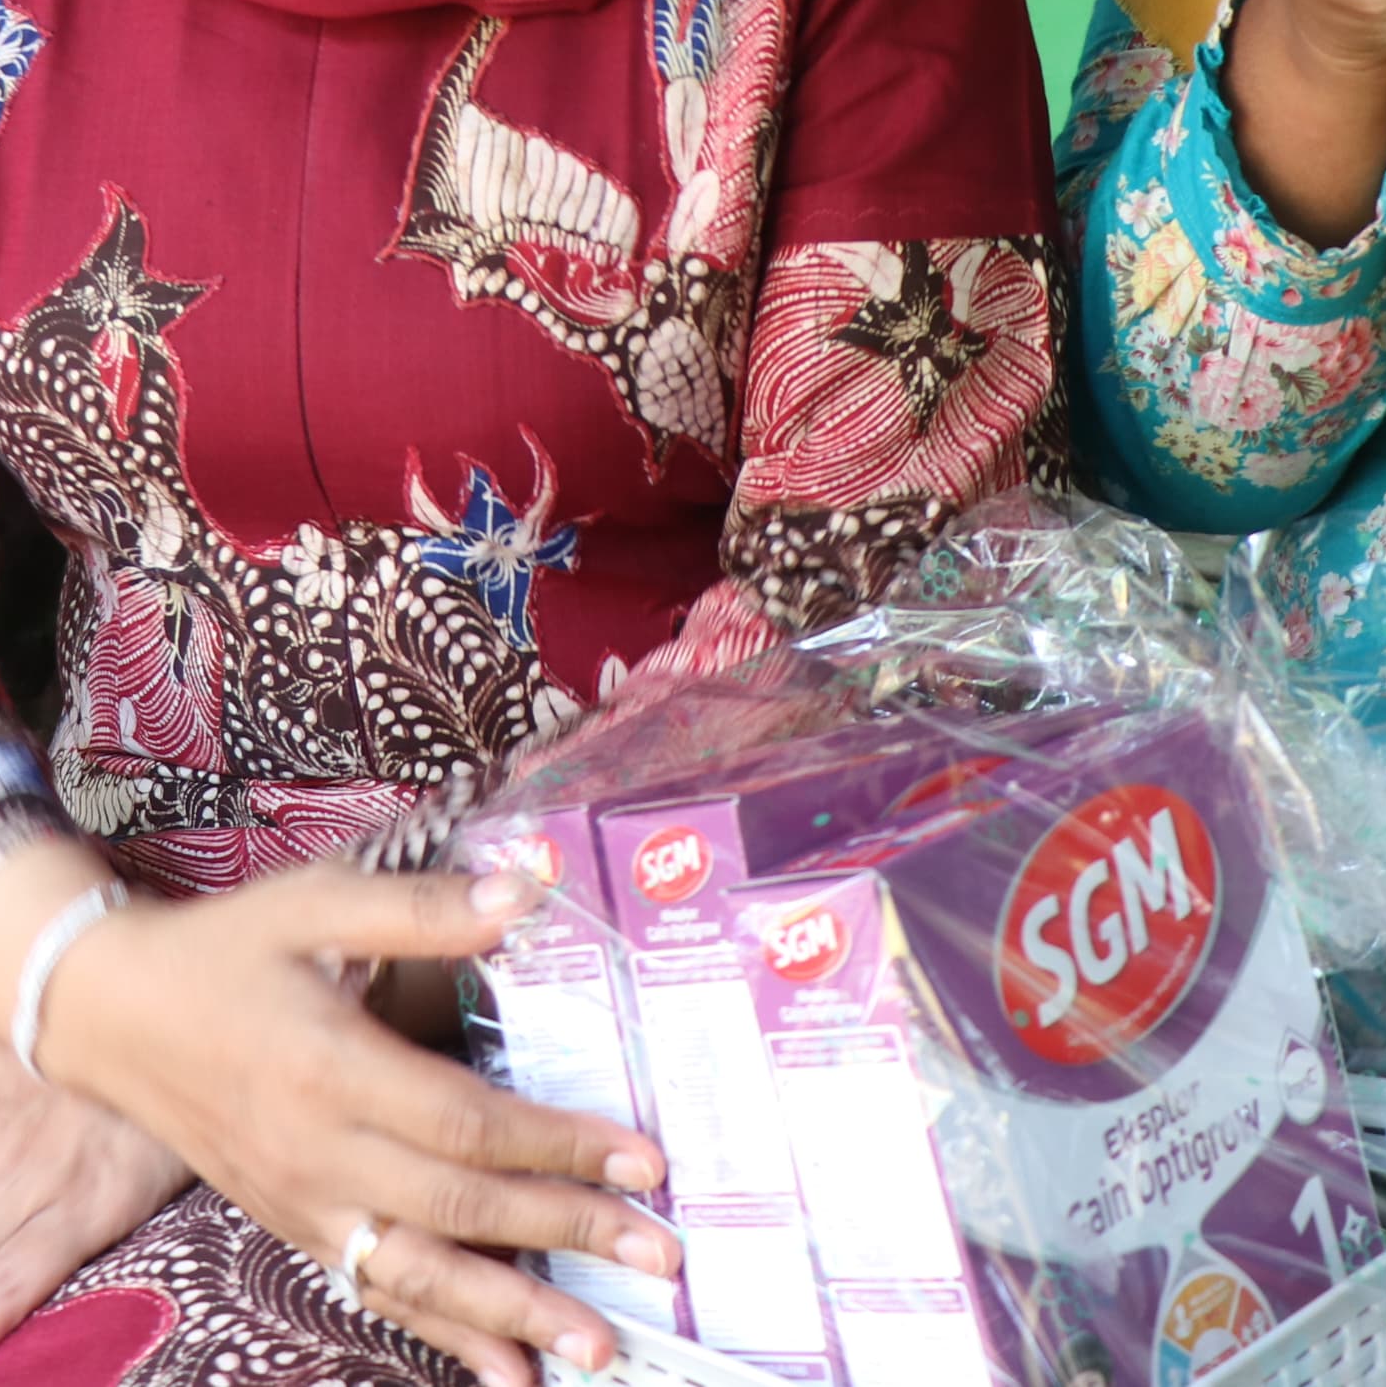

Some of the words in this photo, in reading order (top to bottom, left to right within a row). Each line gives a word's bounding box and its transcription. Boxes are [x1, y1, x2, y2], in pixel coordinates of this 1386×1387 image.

[640, 834, 702, 889] SGM
[769, 912, 838, 969] SGM
[1021, 807, 1192, 1029] SGM
[1103, 1081, 1201, 1160] Eksplor
[1290, 1174, 1347, 1286] 1
